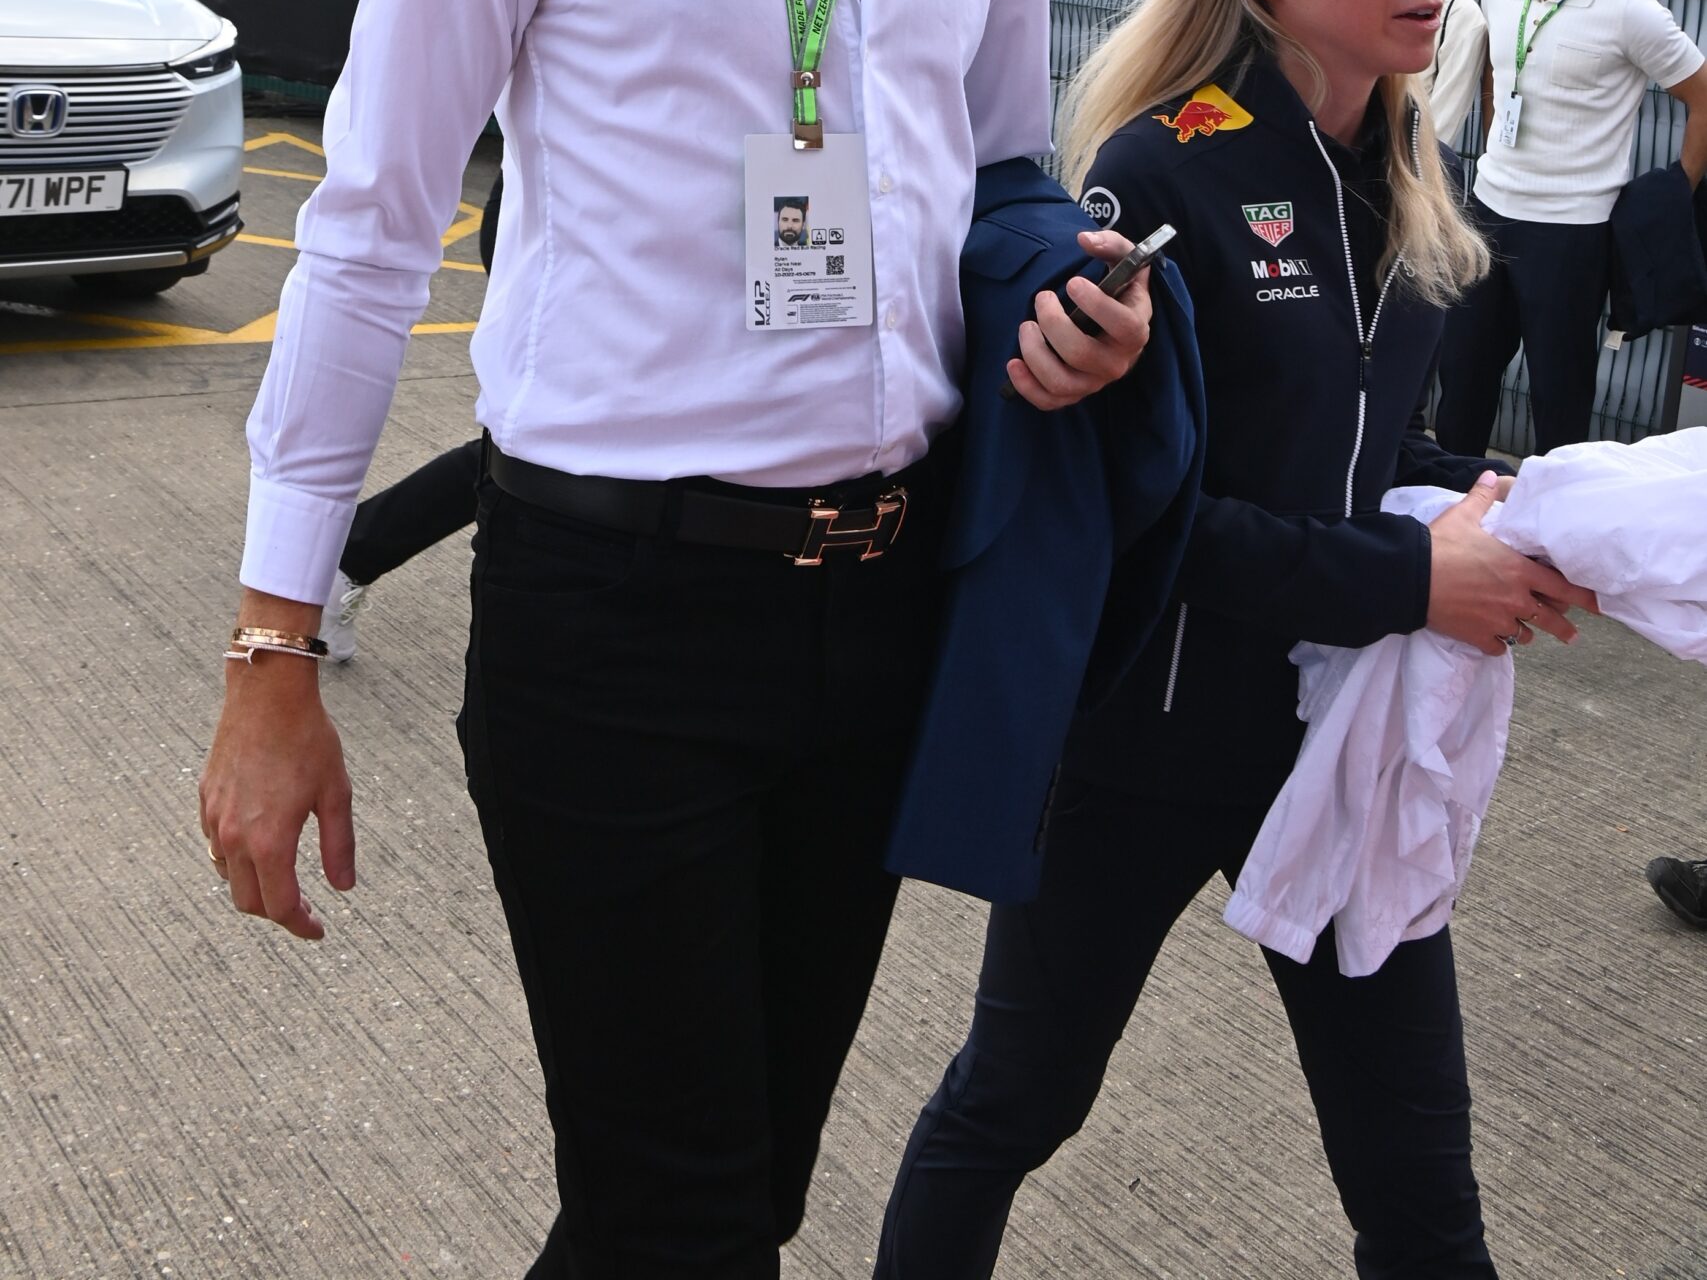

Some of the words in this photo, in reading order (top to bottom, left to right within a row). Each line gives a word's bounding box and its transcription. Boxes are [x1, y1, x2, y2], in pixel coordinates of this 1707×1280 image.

[797, 9, 806, 36] MADE
[812, 15, 823, 35] NET
[0, 177, 35, 210] 71
[44, 175, 106, 207] WPF
[1246, 205, 1288, 221] TAG
[1251, 221, 1290, 244] HEUER
[755, 280, 765, 326] VIP
[1256, 285, 1320, 302] ORACLE
